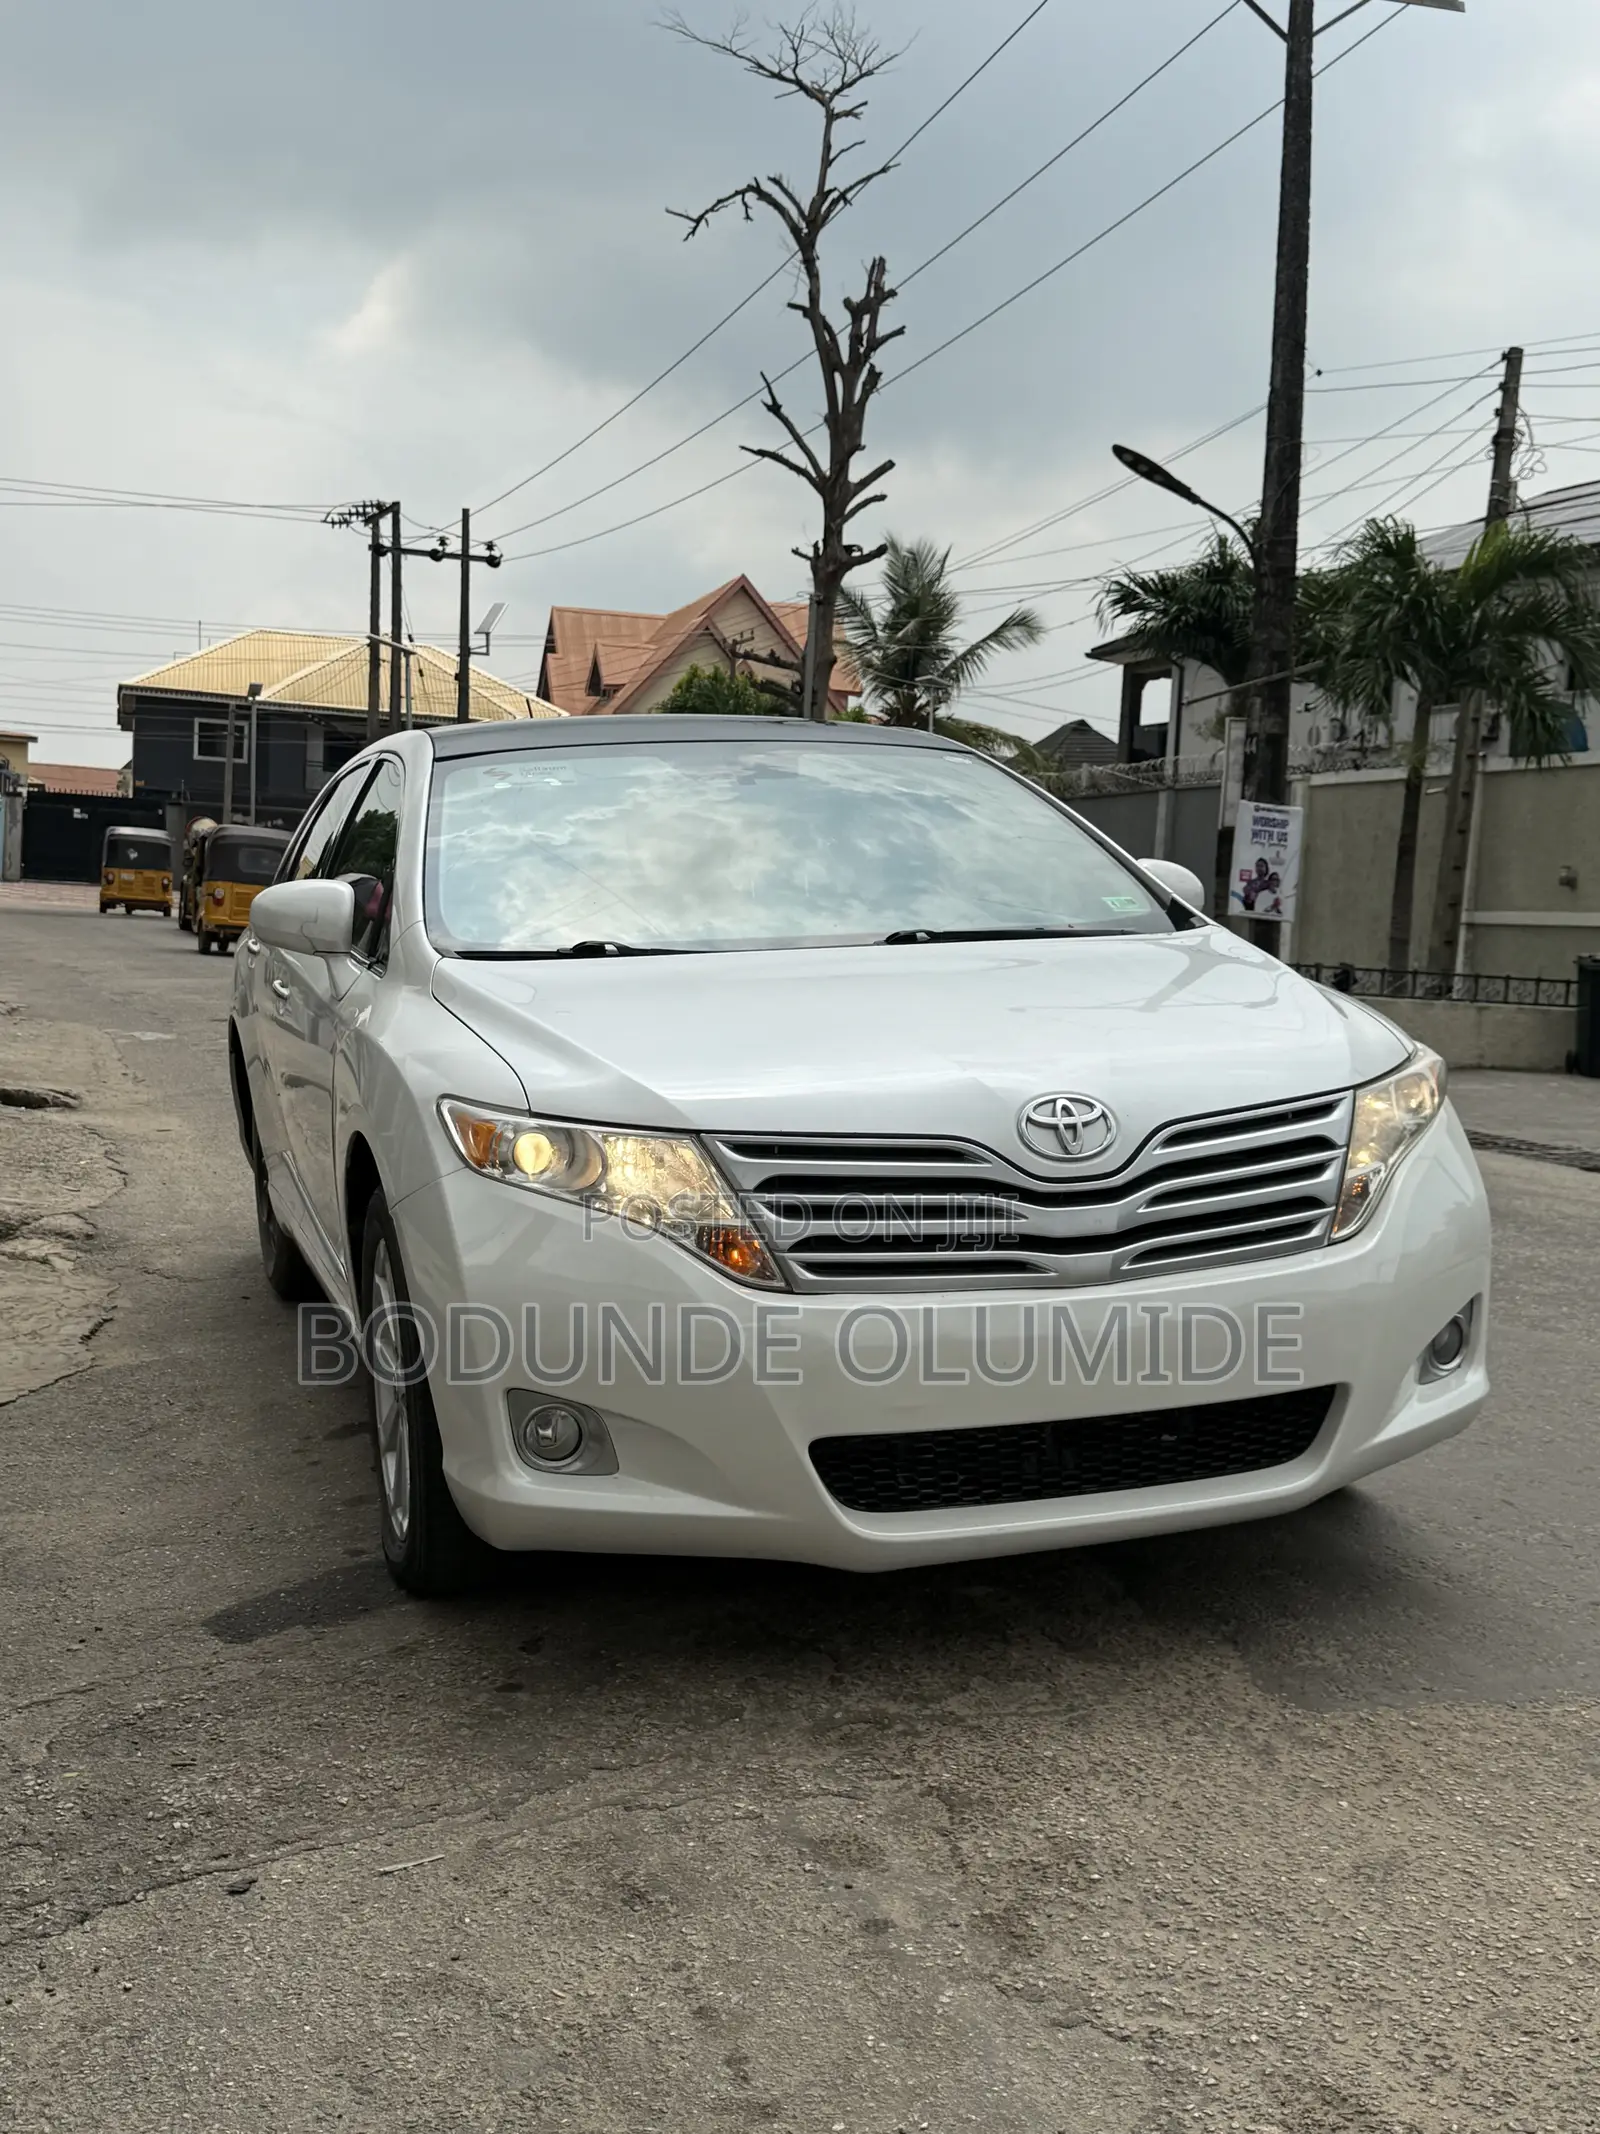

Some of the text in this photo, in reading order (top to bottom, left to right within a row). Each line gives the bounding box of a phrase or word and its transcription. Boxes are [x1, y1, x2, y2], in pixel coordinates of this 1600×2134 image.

[1252, 815, 1289, 829] WORSHIP
[1251, 829, 1288, 842] WITH US
